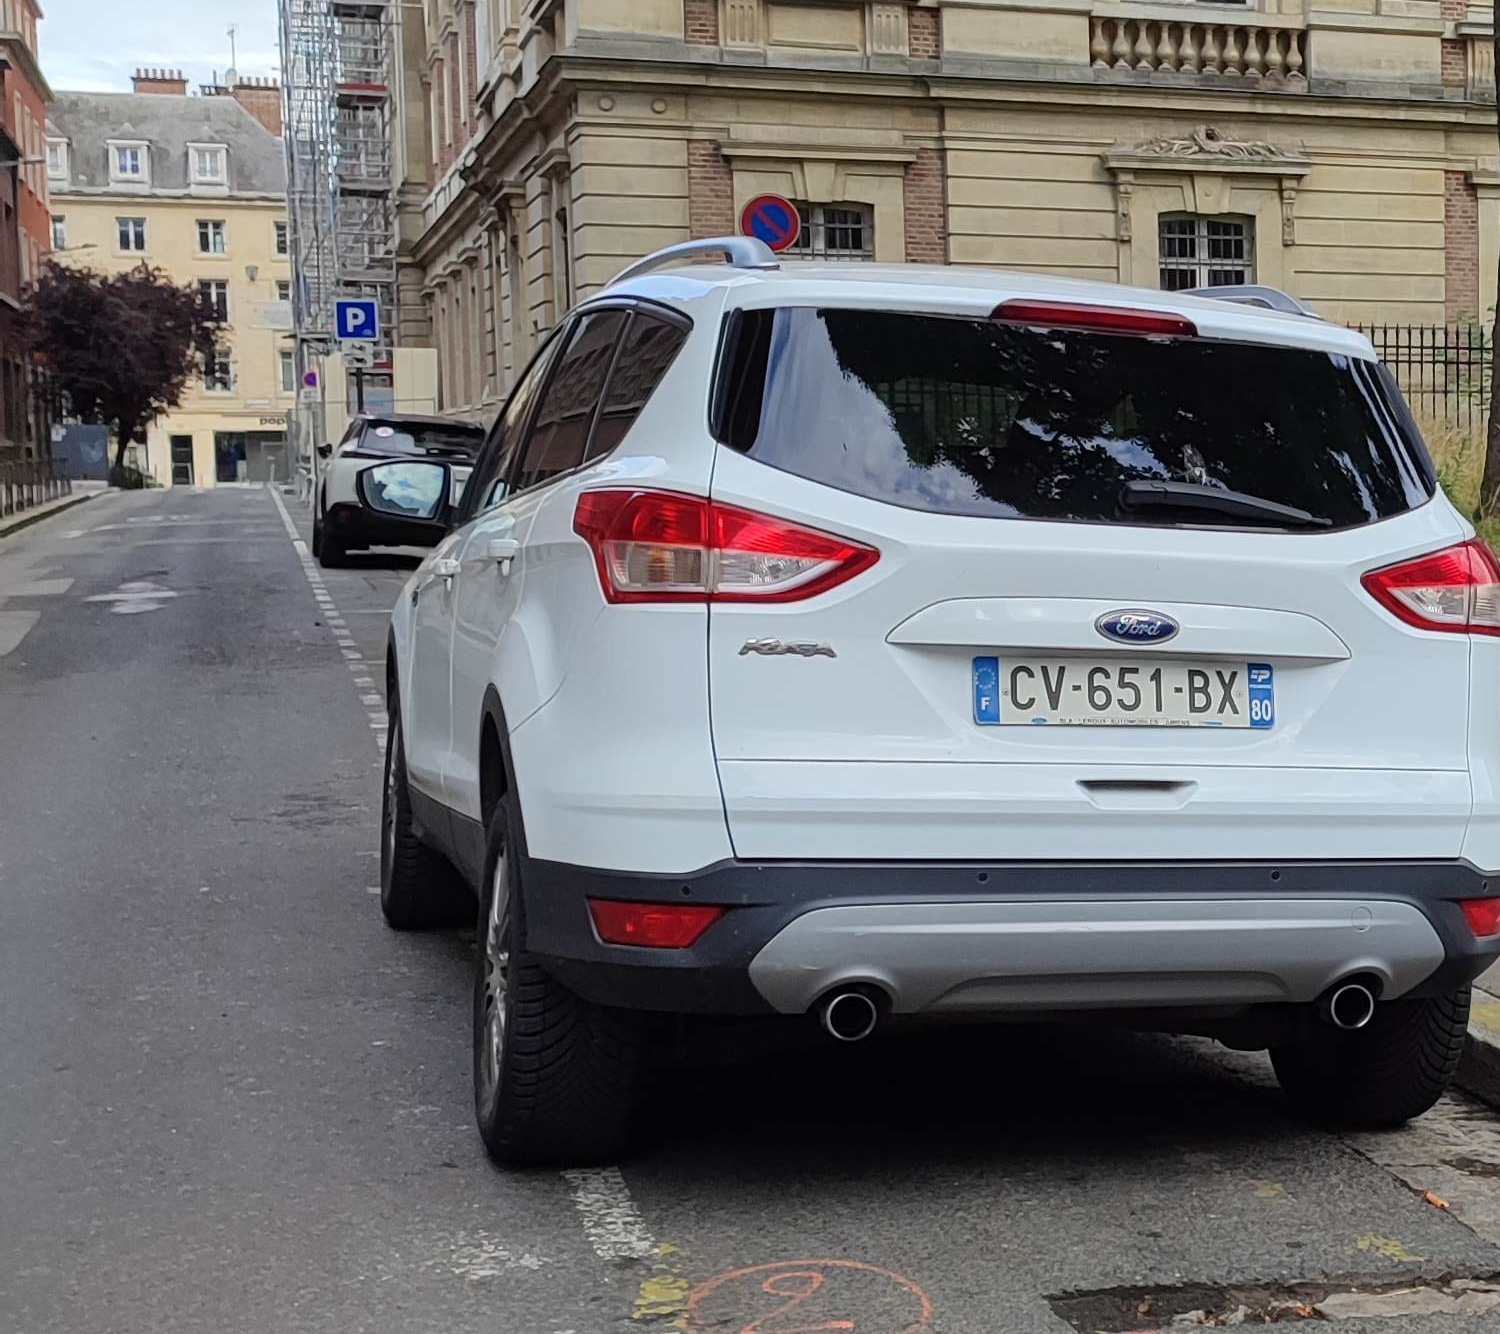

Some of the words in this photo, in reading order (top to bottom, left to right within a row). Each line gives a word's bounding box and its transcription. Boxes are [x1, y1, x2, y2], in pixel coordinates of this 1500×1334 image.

[345, 306, 366, 334] P
[1115, 614, 1162, 636] Ford
[1009, 664, 1240, 716] CV-651-BX
[980, 696, 992, 712] F
[1250, 698, 1272, 722] 80
